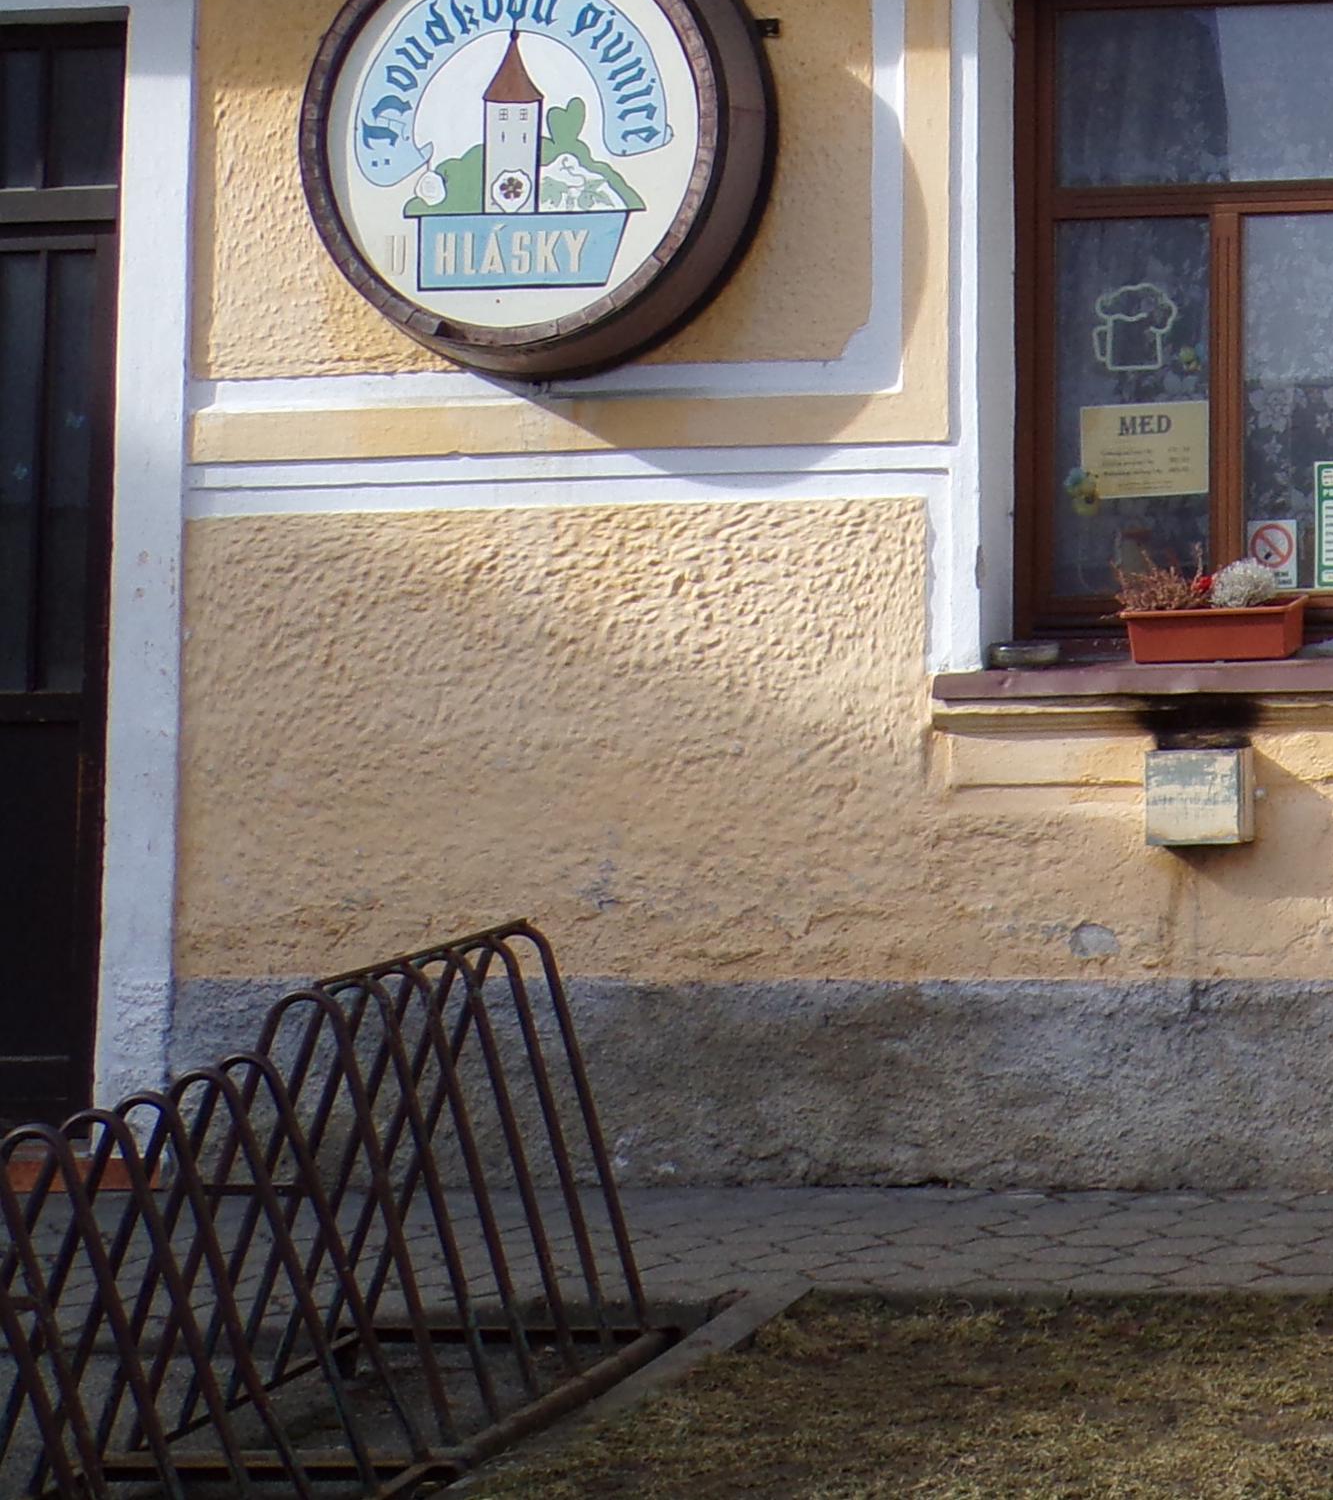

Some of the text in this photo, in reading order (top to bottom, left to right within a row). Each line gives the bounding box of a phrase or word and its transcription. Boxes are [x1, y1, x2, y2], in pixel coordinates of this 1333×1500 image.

[567, 2, 661, 144] pivnice
[434, 223, 589, 276] HLÁSKY
[1118, 414, 1172, 436] MED
